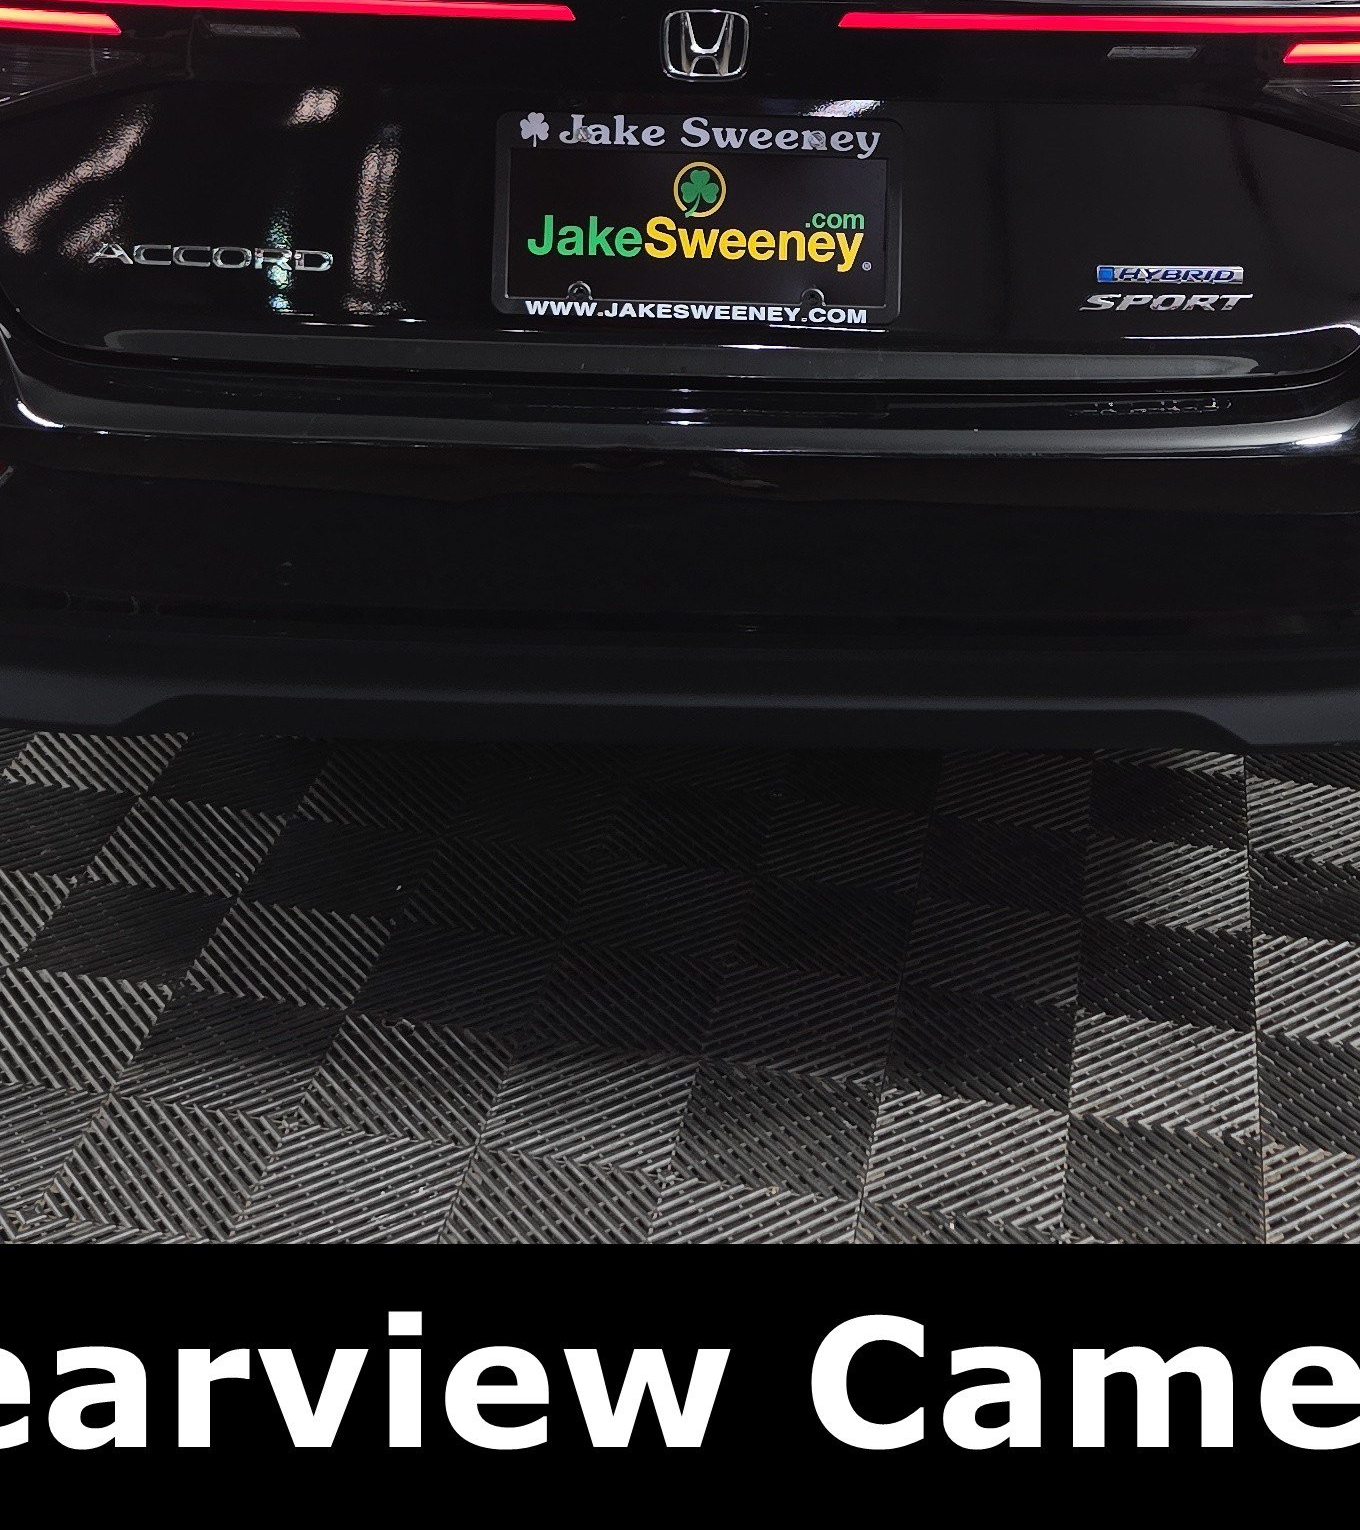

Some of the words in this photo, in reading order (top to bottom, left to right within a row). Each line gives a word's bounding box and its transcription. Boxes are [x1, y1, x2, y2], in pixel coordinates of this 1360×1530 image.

[558, 113, 666, 147] Jake
[680, 117, 881, 159] Sweeney
[88, 243, 334, 272] ACCORD
[1117, 267, 1236, 283] HYBRID
[525, 300, 868, 324] WWW.JAKESWEENEY.COM
[1079, 294, 1254, 311] SPORT
